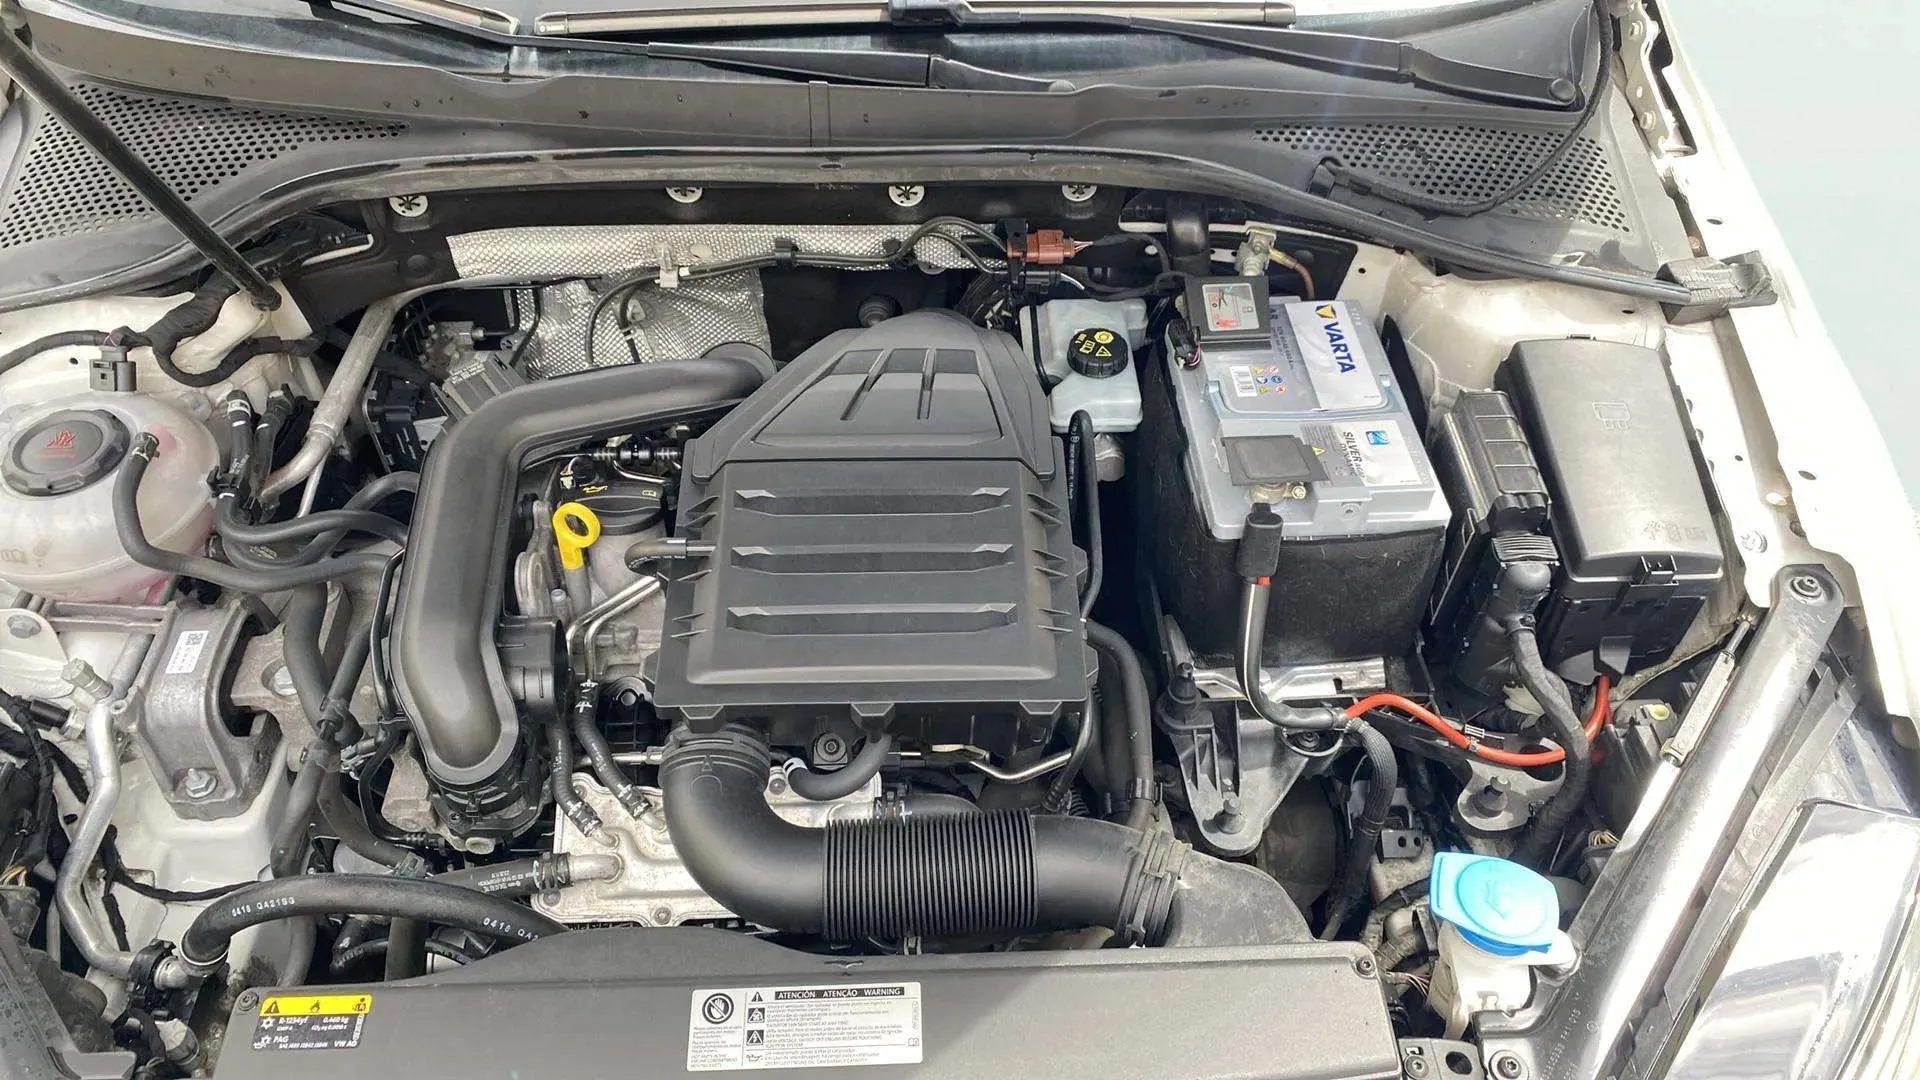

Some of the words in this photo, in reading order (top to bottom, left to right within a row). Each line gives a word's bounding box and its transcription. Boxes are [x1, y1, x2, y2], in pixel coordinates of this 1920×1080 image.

[1324, 322, 1356, 373] VARTA
[1343, 431, 1362, 462] SILVER
[1340, 443, 1358, 477] DYNAMIC
[778, 990, 816, 1000] ATENCIÓN
[863, 986, 901, 997] WARNING
[279, 1016, 308, 1025] R-1234yf
[333, 1040, 347, 1048] VW
